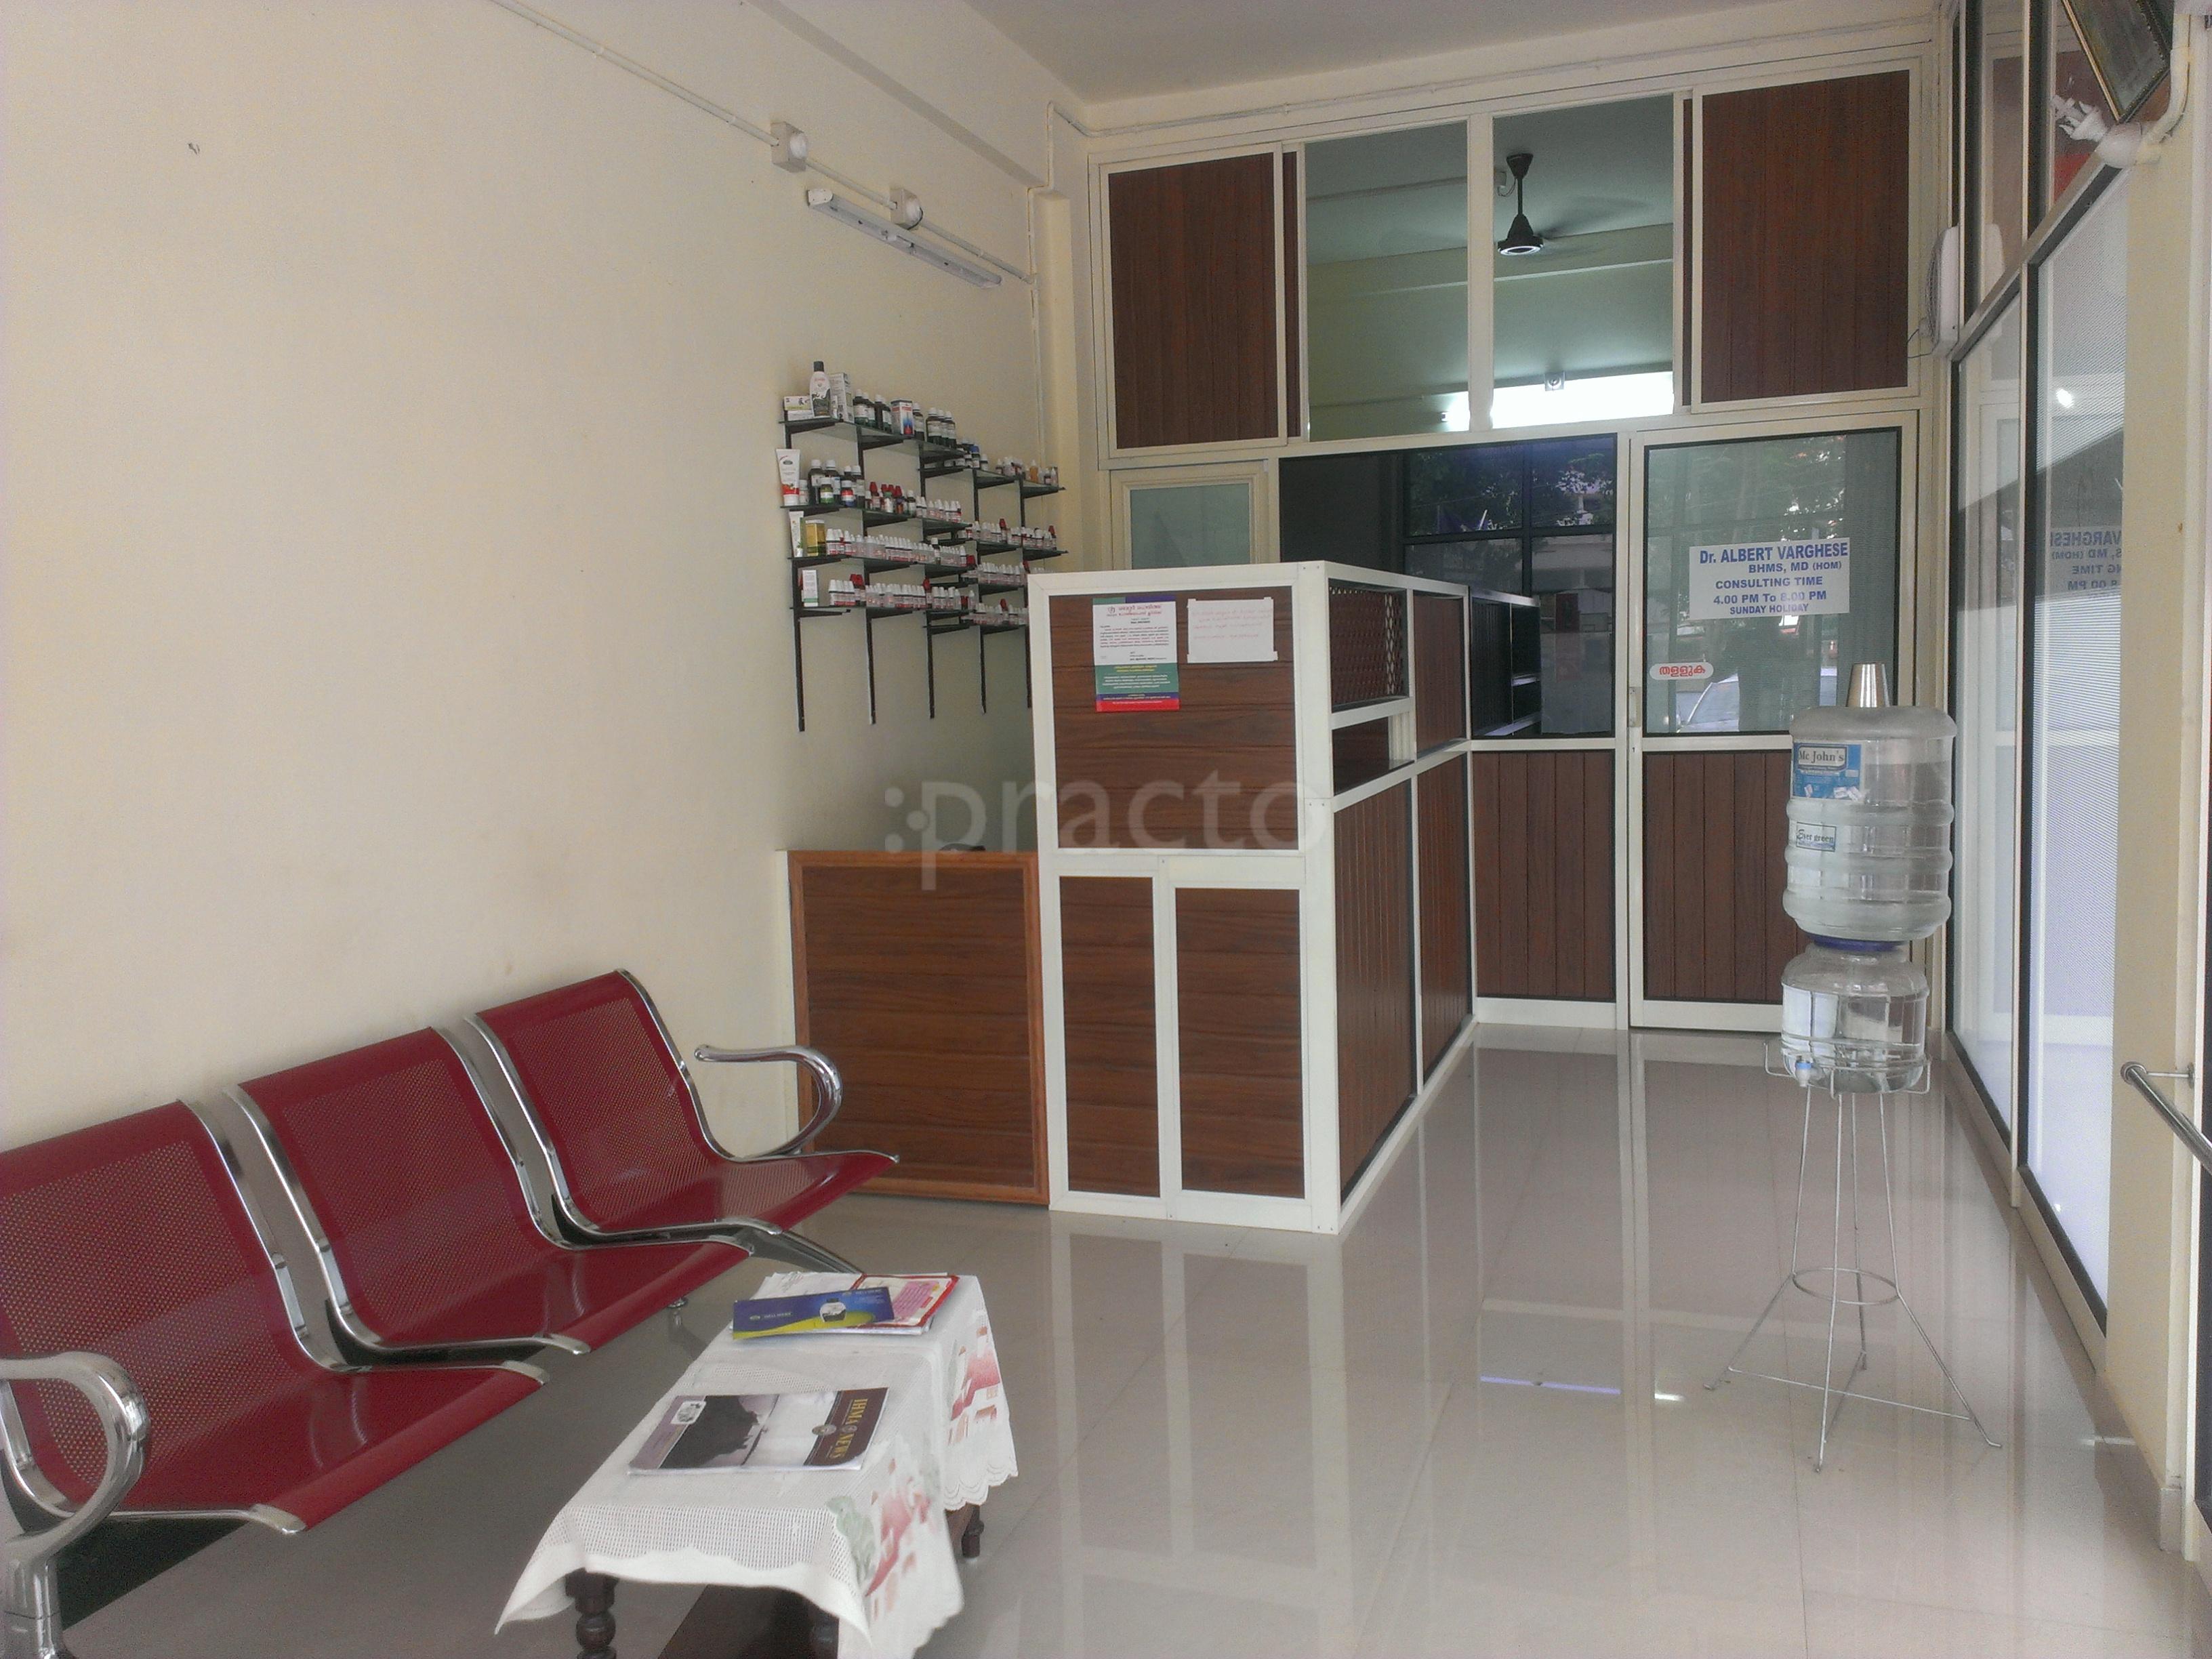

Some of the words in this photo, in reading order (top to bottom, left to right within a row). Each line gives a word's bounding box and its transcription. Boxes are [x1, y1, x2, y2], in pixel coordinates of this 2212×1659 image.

[1700, 550, 1716, 564] Dr.
[1721, 547, 1773, 562] ALBERT
[1778, 542, 1848, 560] VARGHESE
[1748, 563, 1786, 573] BHMS,
[1790, 562, 1809, 571] MD
[1813, 561, 1842, 571] (HOM)
[1716, 577, 1790, 590] CONSULTING
[1795, 576, 1823, 586] TIME
[1713, 595, 1738, 605] 4.00
[1742, 594, 1759, 603] PM
[1763, 593, 1776, 602] To
[1809, 590, 1826, 600] PM
[1729, 606, 1766, 615] SUNDAY
[1769, 604, 1809, 613] HOLIDAY
[1799, 750, 1809, 760] Mc
[1811, 750, 1844, 763] John's
[845, 1399, 867, 1425] IHMA
[829, 1433, 855, 1459] NEWS
